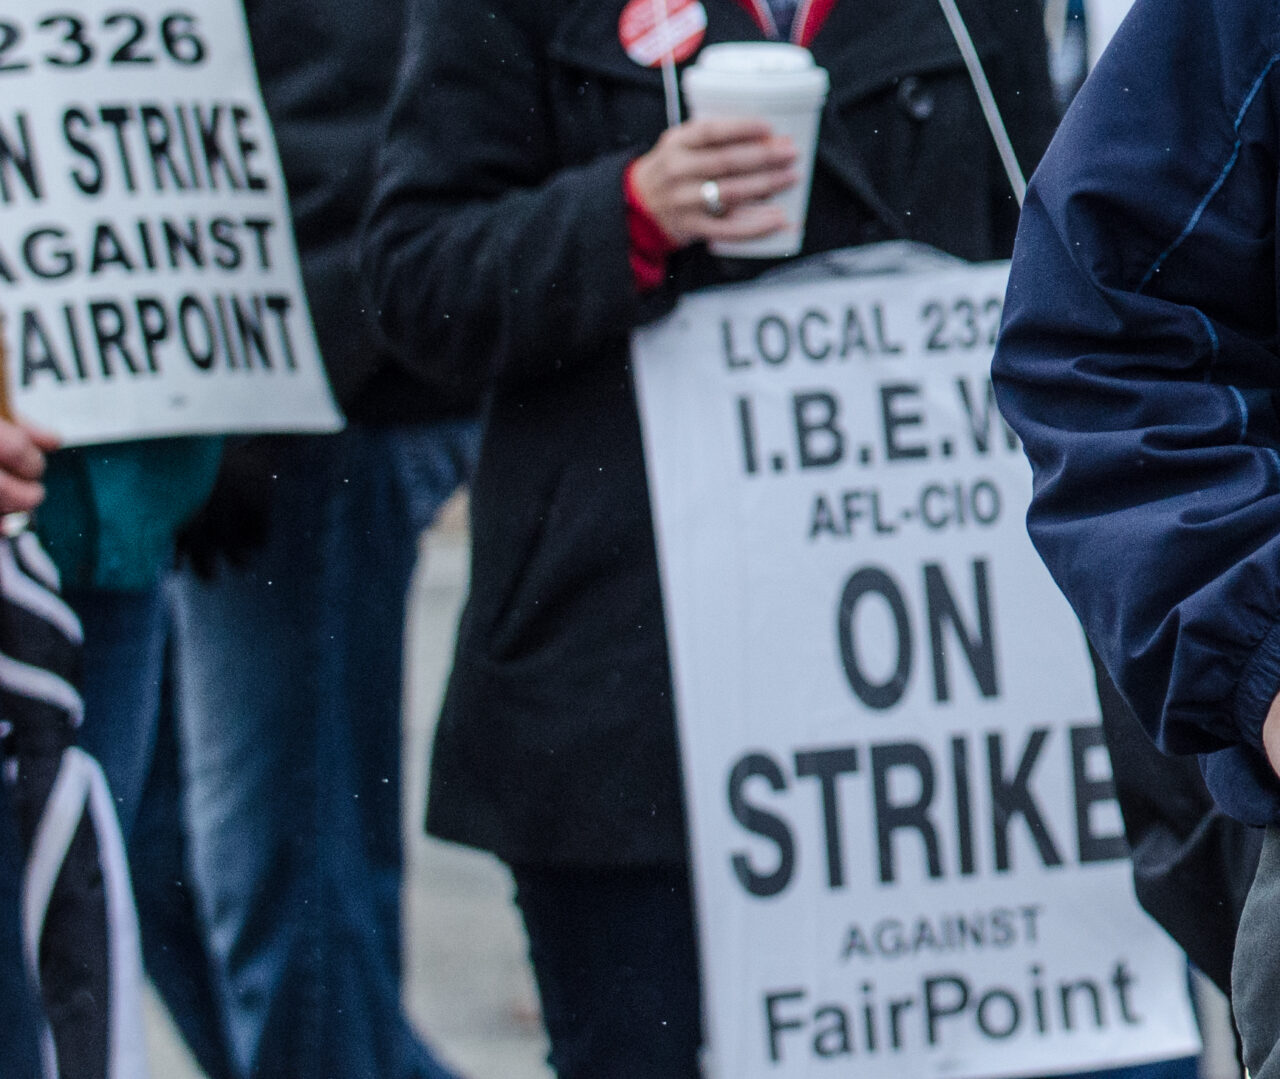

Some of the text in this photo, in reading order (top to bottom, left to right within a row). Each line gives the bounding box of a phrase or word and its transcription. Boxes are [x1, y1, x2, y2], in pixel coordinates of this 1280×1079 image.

[63, 103, 268, 195] STRIKE
[720, 305, 902, 372] LOCAL
[808, 479, 1004, 542] AFL-CIO
[836, 557, 1004, 712] ON
[726, 721, 1132, 898] STRIKE
[842, 905, 1041, 960] AGAINST
[763, 960, 1140, 1063] FairPoint
